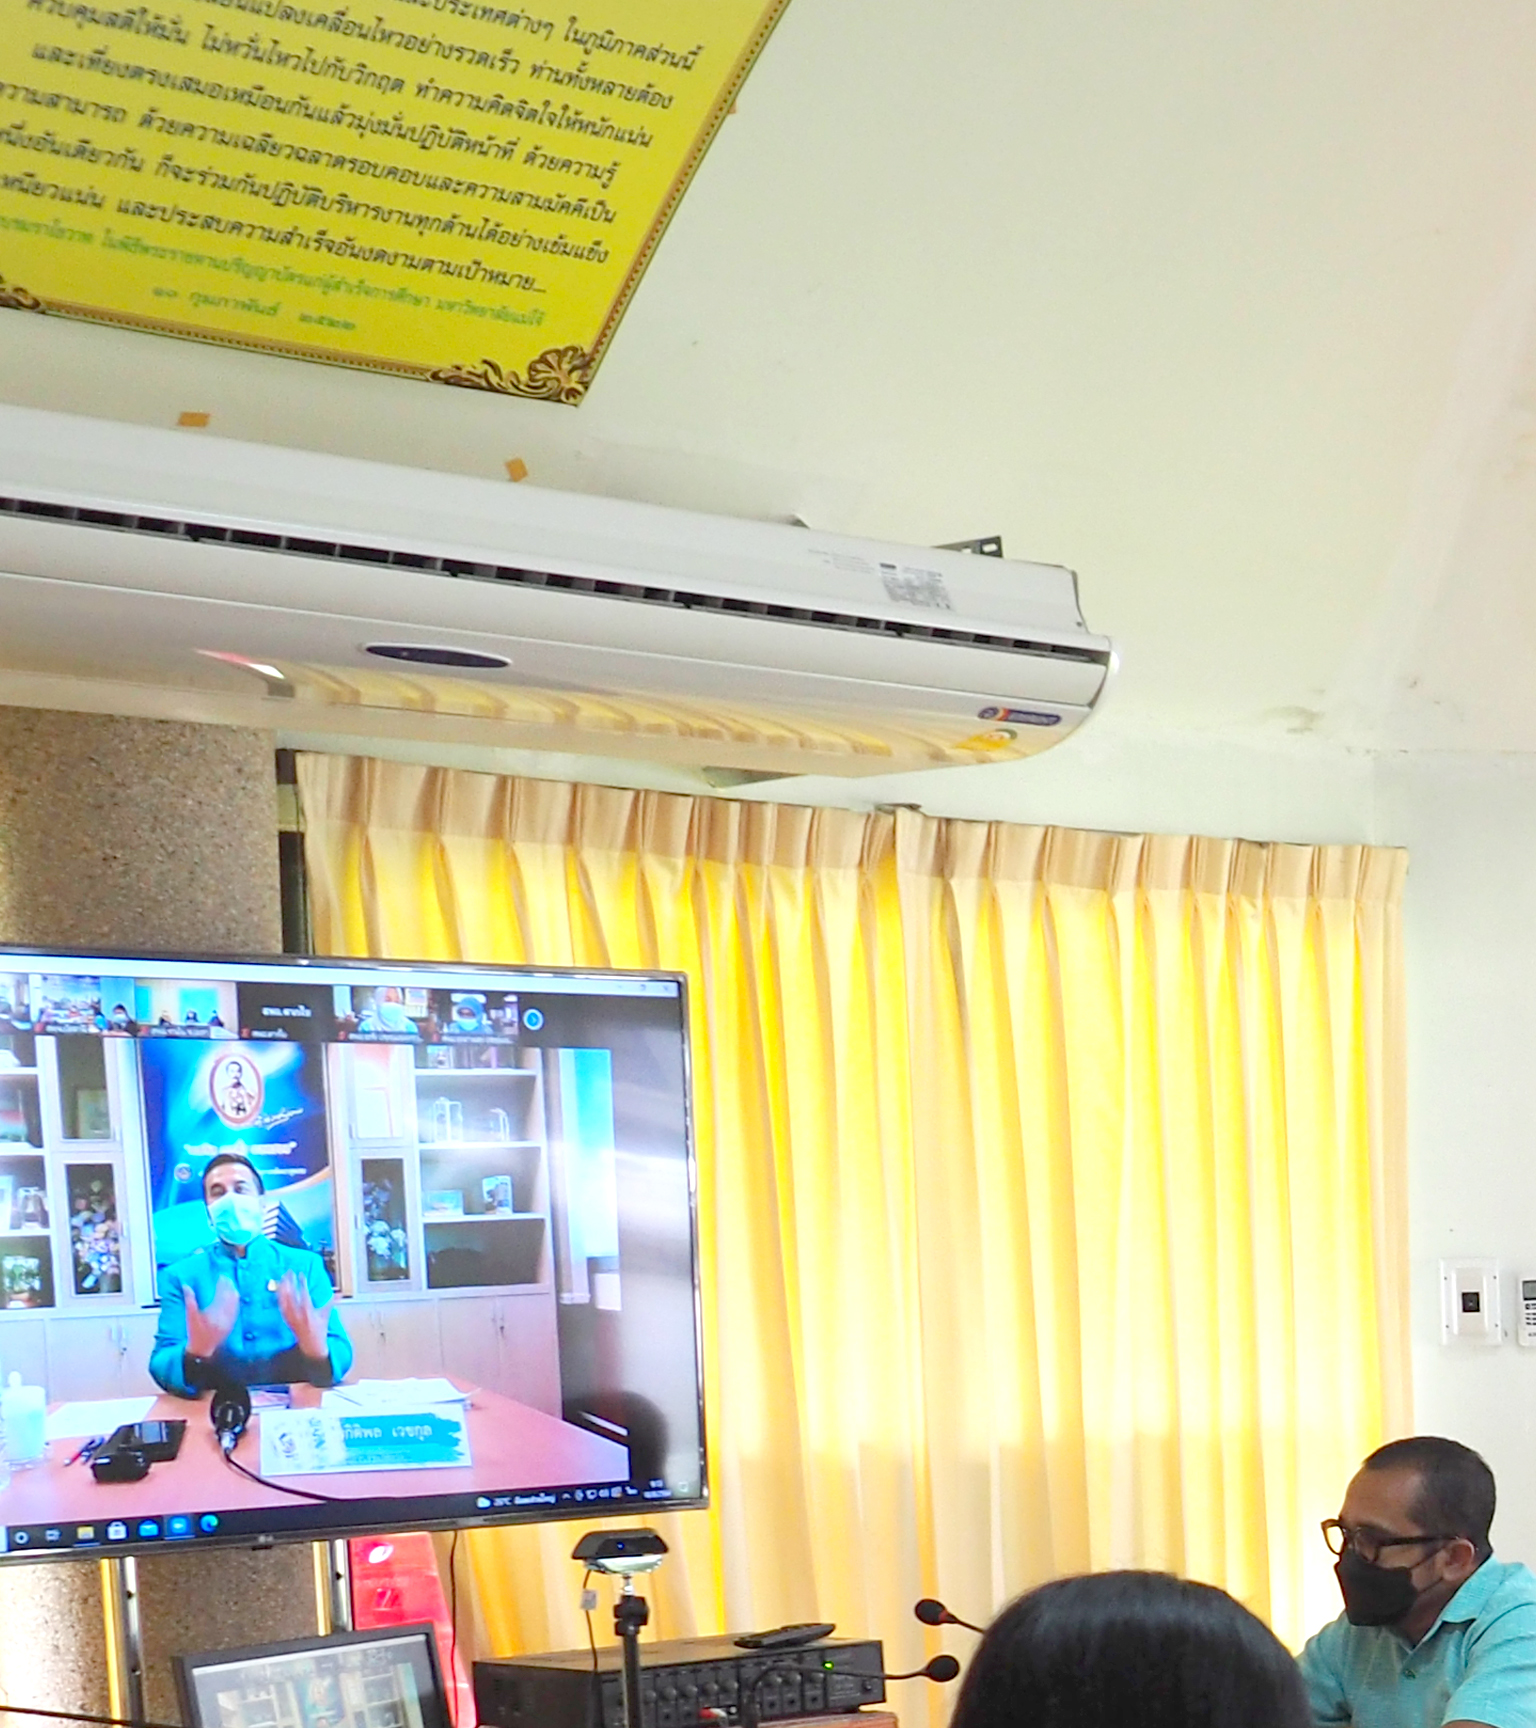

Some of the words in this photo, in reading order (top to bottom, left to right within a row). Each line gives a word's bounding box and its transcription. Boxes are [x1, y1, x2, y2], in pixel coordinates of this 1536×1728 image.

[563, 15, 704, 71] ในภูมิภาคส่วนนี้
[0, 80, 127, 123] วามสามารถ
[530, 60, 674, 109] ท่านทั้งหลายต้อง
[416, 77, 653, 148] ทำความคิดจิตใจให้หนักแน่น
[523, 144, 621, 189] ด้วยความรู้
